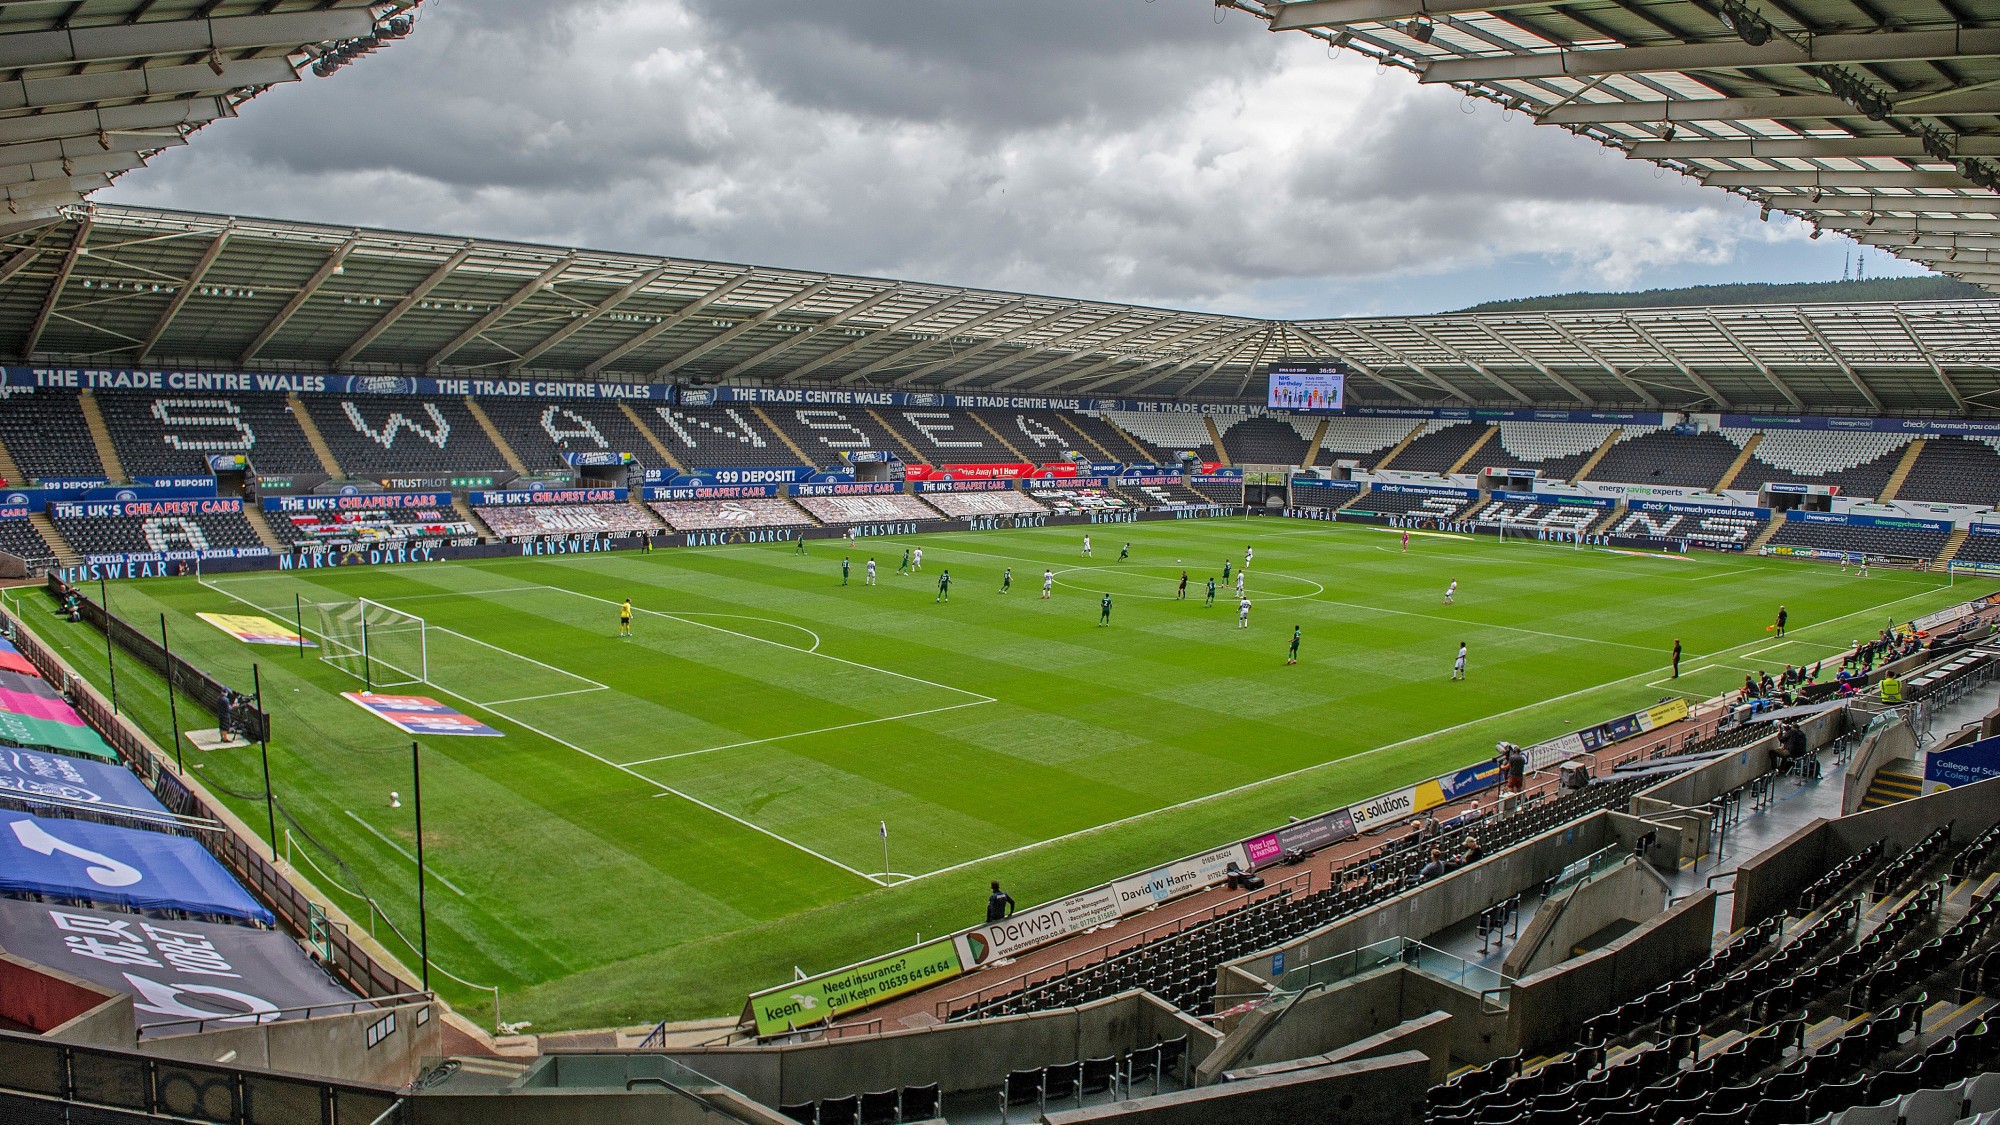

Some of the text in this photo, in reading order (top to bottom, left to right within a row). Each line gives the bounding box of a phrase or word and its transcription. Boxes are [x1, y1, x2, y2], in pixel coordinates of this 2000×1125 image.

[33, 370, 325, 392] THE TRADE CENTRE WALES
[436, 380, 650, 398] THE TRADE CENTRE WALES
[732, 388, 892, 404] THE TRADE CENTRE WALES
[976, 397, 1079, 410] TRADE CENTRE WALES
[1160, 402, 1246, 414] TRADE CENTRE
[1903, 420, 1926, 428] check
[646, 470, 661, 478] £99
[716, 470, 796, 484] £99 DEPOSIT!
[958, 468, 973, 476] Drive
[976, 468, 992, 476] Away
[1003, 468, 1018, 476] Hour
[44, 482, 60, 490] £99
[155, 479, 213, 488] £99 DEPOSIT!
[392, 478, 448, 488] TRUSTPILOT
[815, 483, 894, 494] UK'S CHEAPEST CARS
[937, 480, 1006, 490] UK'S CHEAPEST CARS
[1382, 484, 1400, 492] check
[484, 490, 615, 504] THE UK'S CHEAPEST CARS
[654, 486, 765, 498] THE UK'S CHEAPEST CARS
[1598, 485, 1682, 497] energy saving experts
[56, 500, 240, 517] THE UK'S CHEAPEST CARS
[280, 494, 436, 510] THE UK'S CHEAPEST CARS
[1558, 498, 1607, 506] theenergycheck.co.uk
[1176, 508, 1234, 519] MARC DARCY
[1283, 508, 1337, 522] MENSWEAR
[1642, 502, 1664, 510] check
[1668, 504, 1683, 512] how
[1717, 508, 1736, 516] could
[536, 514, 608, 528] SWANS
[970, 518, 998, 530] MARC
[1015, 517, 1046, 528] DARCY
[1090, 512, 1137, 524] MENSWEAR
[1806, 513, 1844, 522] theenergycheck
[1875, 518, 1940, 530] theenergycheck.co.uk
[855, 523, 917, 537] MENSWEAR
[1390, 517, 1476, 534] MARC DARCY
[457, 538, 478, 547] YOBET
[687, 530, 791, 546] MARC DARCY
[1538, 530, 1610, 546] MENSWEAR
[309, 544, 332, 554] YOBET
[348, 543, 370, 552] YOBET
[522, 538, 611, 556] MENSWEAR
[279, 548, 430, 570] MARC DARCY
[1561, 736, 1580, 749] Jones
[1936, 760, 1969, 772] College
[1944, 770, 1969, 782] Coleg
[1311, 825, 1328, 834] Problems
[1249, 842, 1262, 852] Peter
[1262, 838, 1276, 848] Lynn
[1256, 846, 1278, 858] PARTNERS
[1208, 870, 1222, 880] 01792
[1122, 870, 1196, 902] David W Harris
[1169, 883, 1192, 894] Solicitors
[1068, 896, 1110, 914] Waste Management
[1070, 903, 1115, 922] Recycled Aggregates
[990, 910, 1064, 947] Derwen
[1080, 918, 1096, 926] 01792
[140, 922, 242, 978] YOBET
[823, 959, 906, 994] Need insurance?
[828, 960, 950, 1008] Call Keen 01639 64 64 64
[766, 1002, 802, 1022] keen
